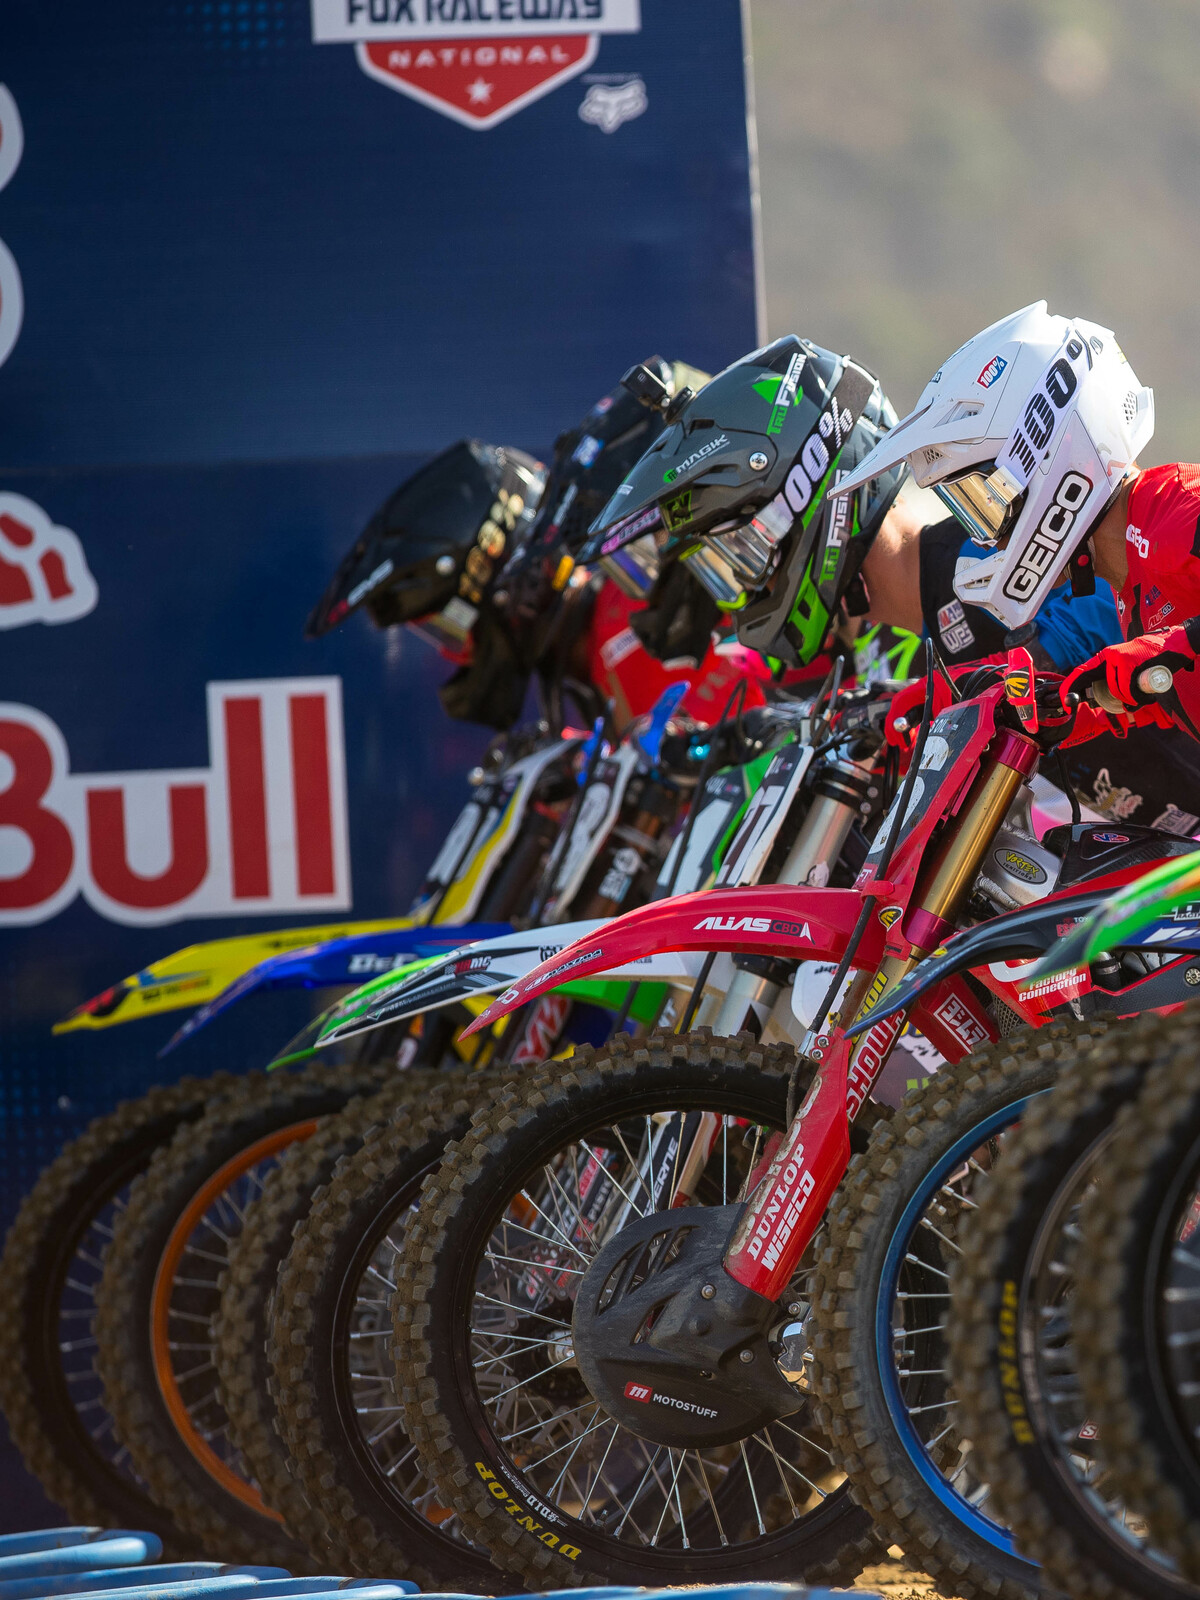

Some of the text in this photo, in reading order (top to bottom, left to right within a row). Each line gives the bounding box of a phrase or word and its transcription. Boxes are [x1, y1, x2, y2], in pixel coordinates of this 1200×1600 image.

[347, 0, 414, 23] FOX
[387, 44, 571, 69] NATIONAL
[979, 357, 1006, 388] 100%
[1005, 472, 1092, 600] GEICO
[0, 692, 337, 913] Bull
[1006, 851, 1039, 878] VORTEX
[773, 921, 800, 934] CBD
[1018, 972, 1087, 1003] Connection
[747, 1144, 806, 1261] DUNLOP
[652, 1393, 718, 1419] MOTOSTUFF
[475, 1462, 582, 1561] DUNLOP
